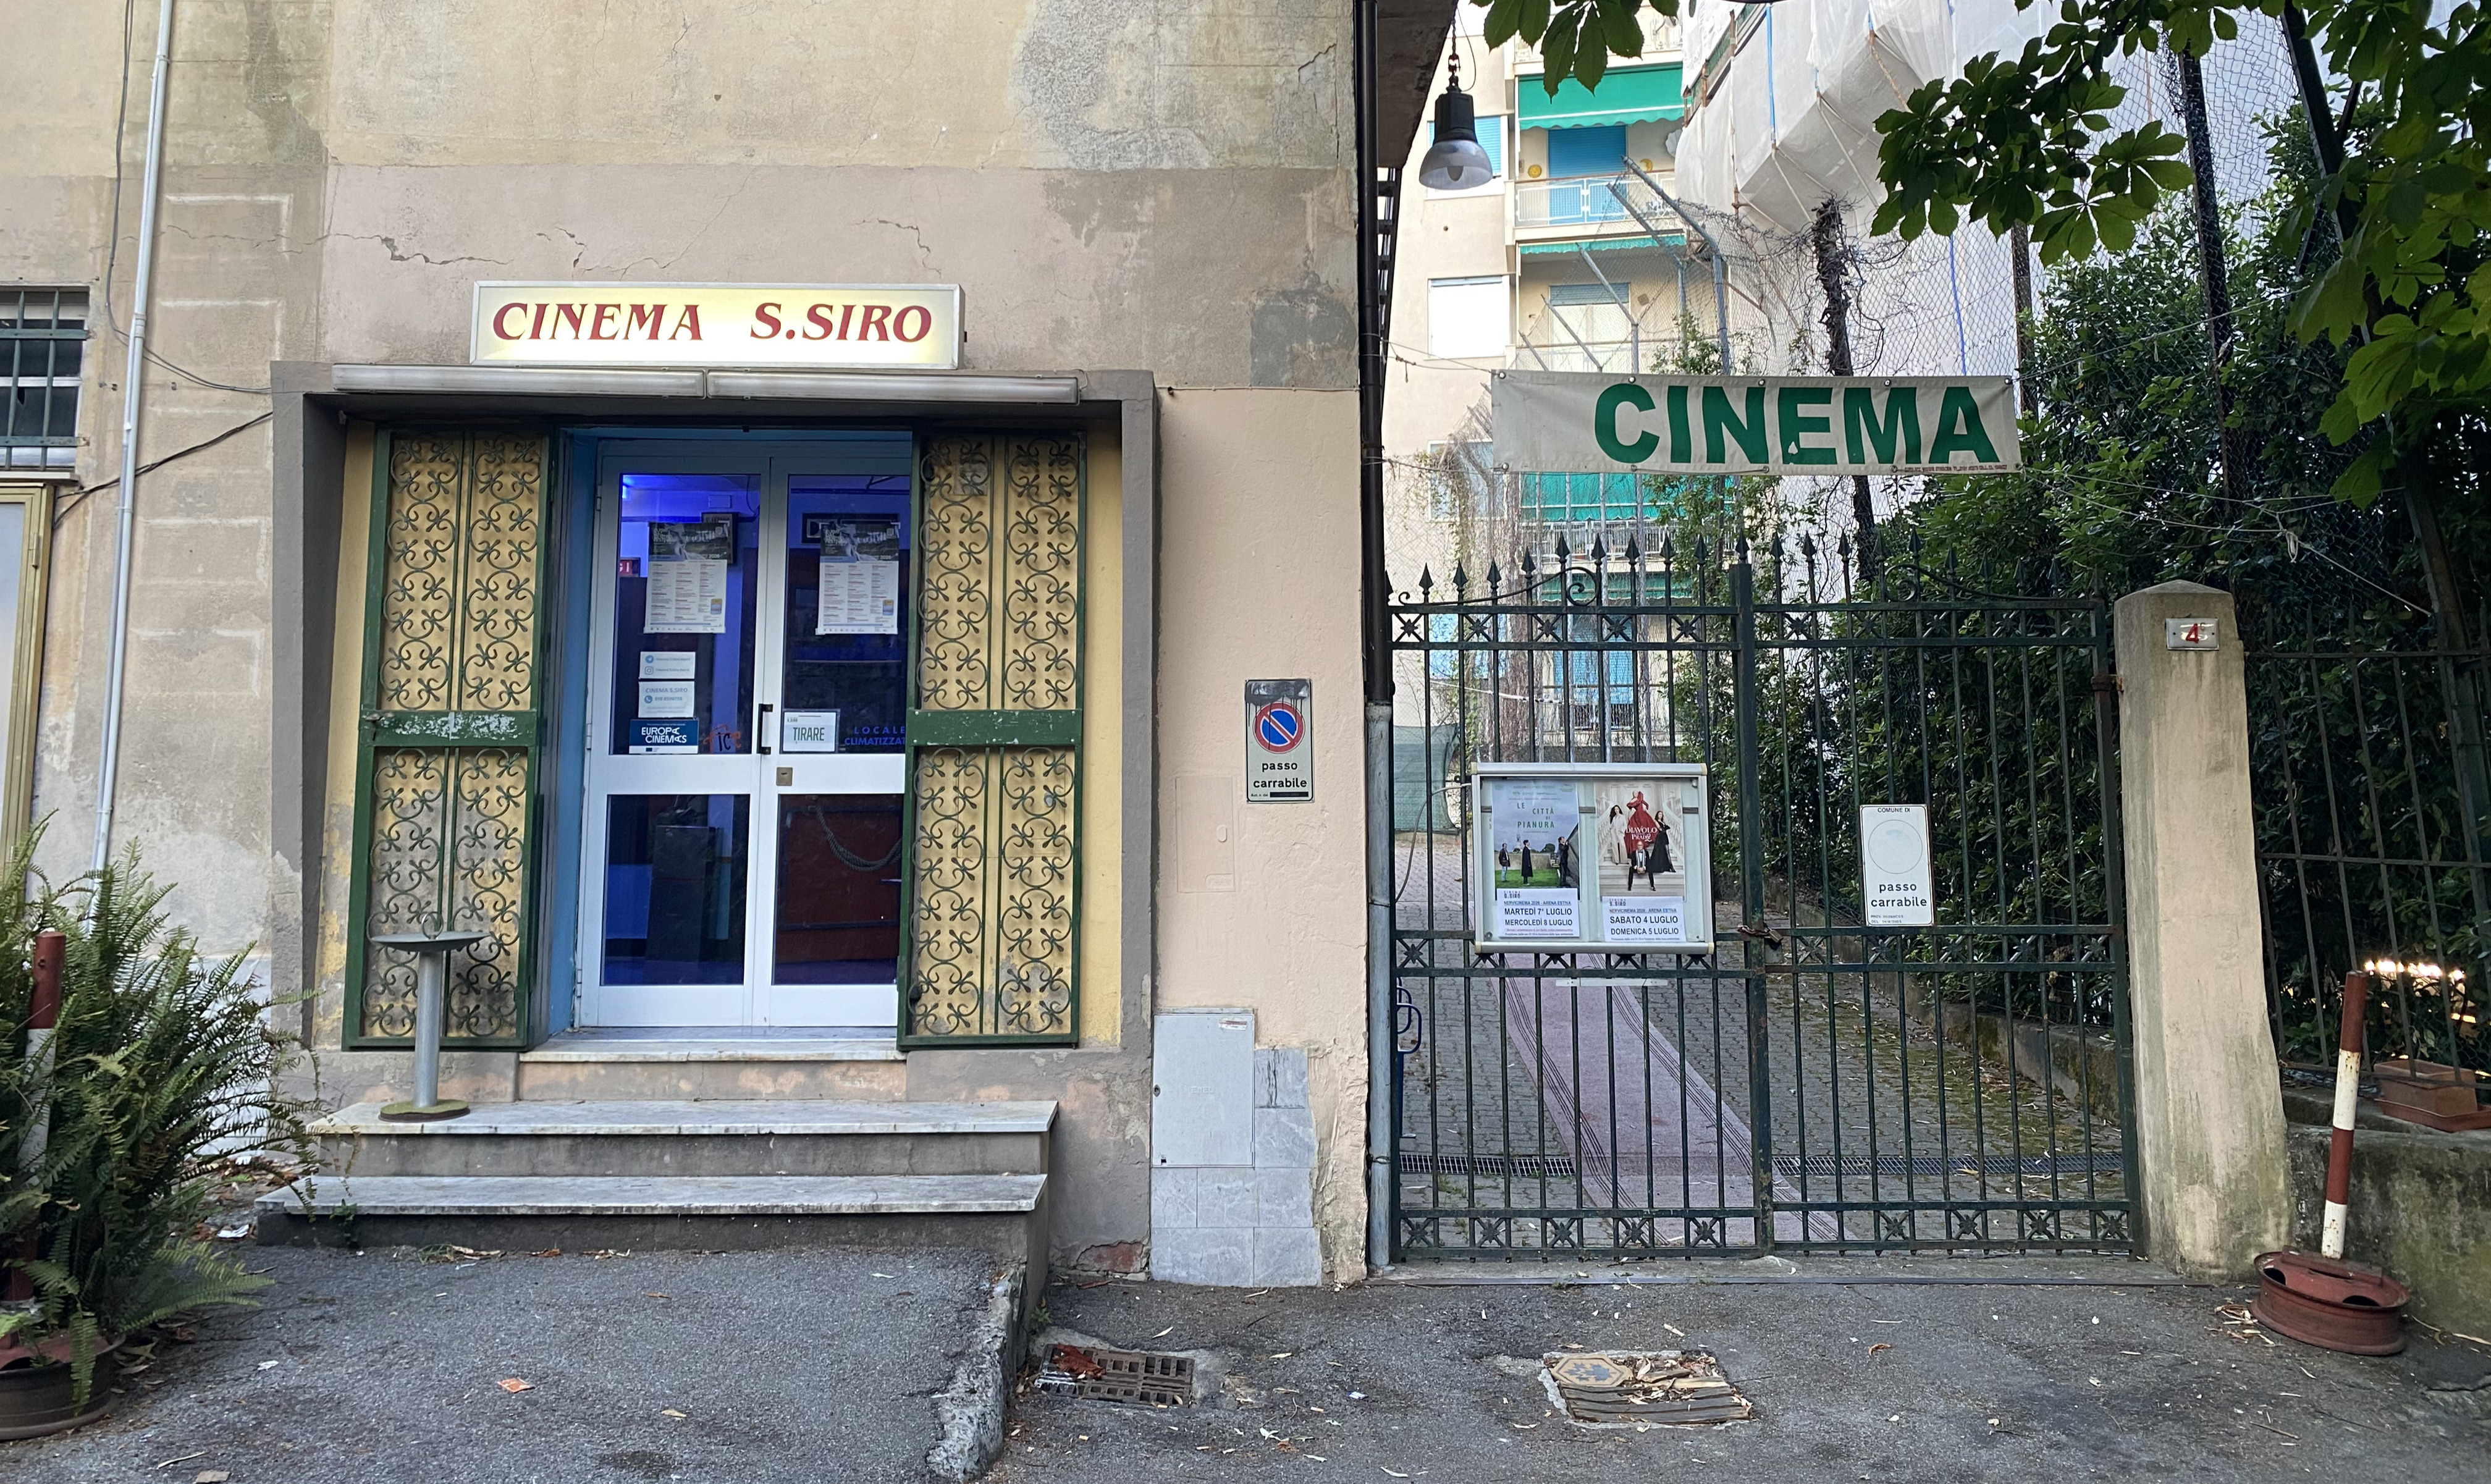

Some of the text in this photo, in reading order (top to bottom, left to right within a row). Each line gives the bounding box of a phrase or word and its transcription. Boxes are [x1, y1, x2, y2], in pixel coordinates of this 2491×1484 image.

[493, 302, 932, 342] CINEMA S.SIRO
[1594, 382, 2000, 465] CINEMA
[641, 727, 680, 735] EUROPA
[793, 727, 825, 741] TIRARE
[854, 726, 906, 735] LOCALE
[645, 735, 687, 743] CINEMAS
[1262, 762, 1297, 772] passo
[1253, 777, 1307, 788] carrabile
[1879, 883, 1917, 893] passo
[1871, 896, 1927, 907] carrabile
[1504, 906, 1536, 915] MARTEDÌ
[1610, 916, 1642, 924] SABATO
